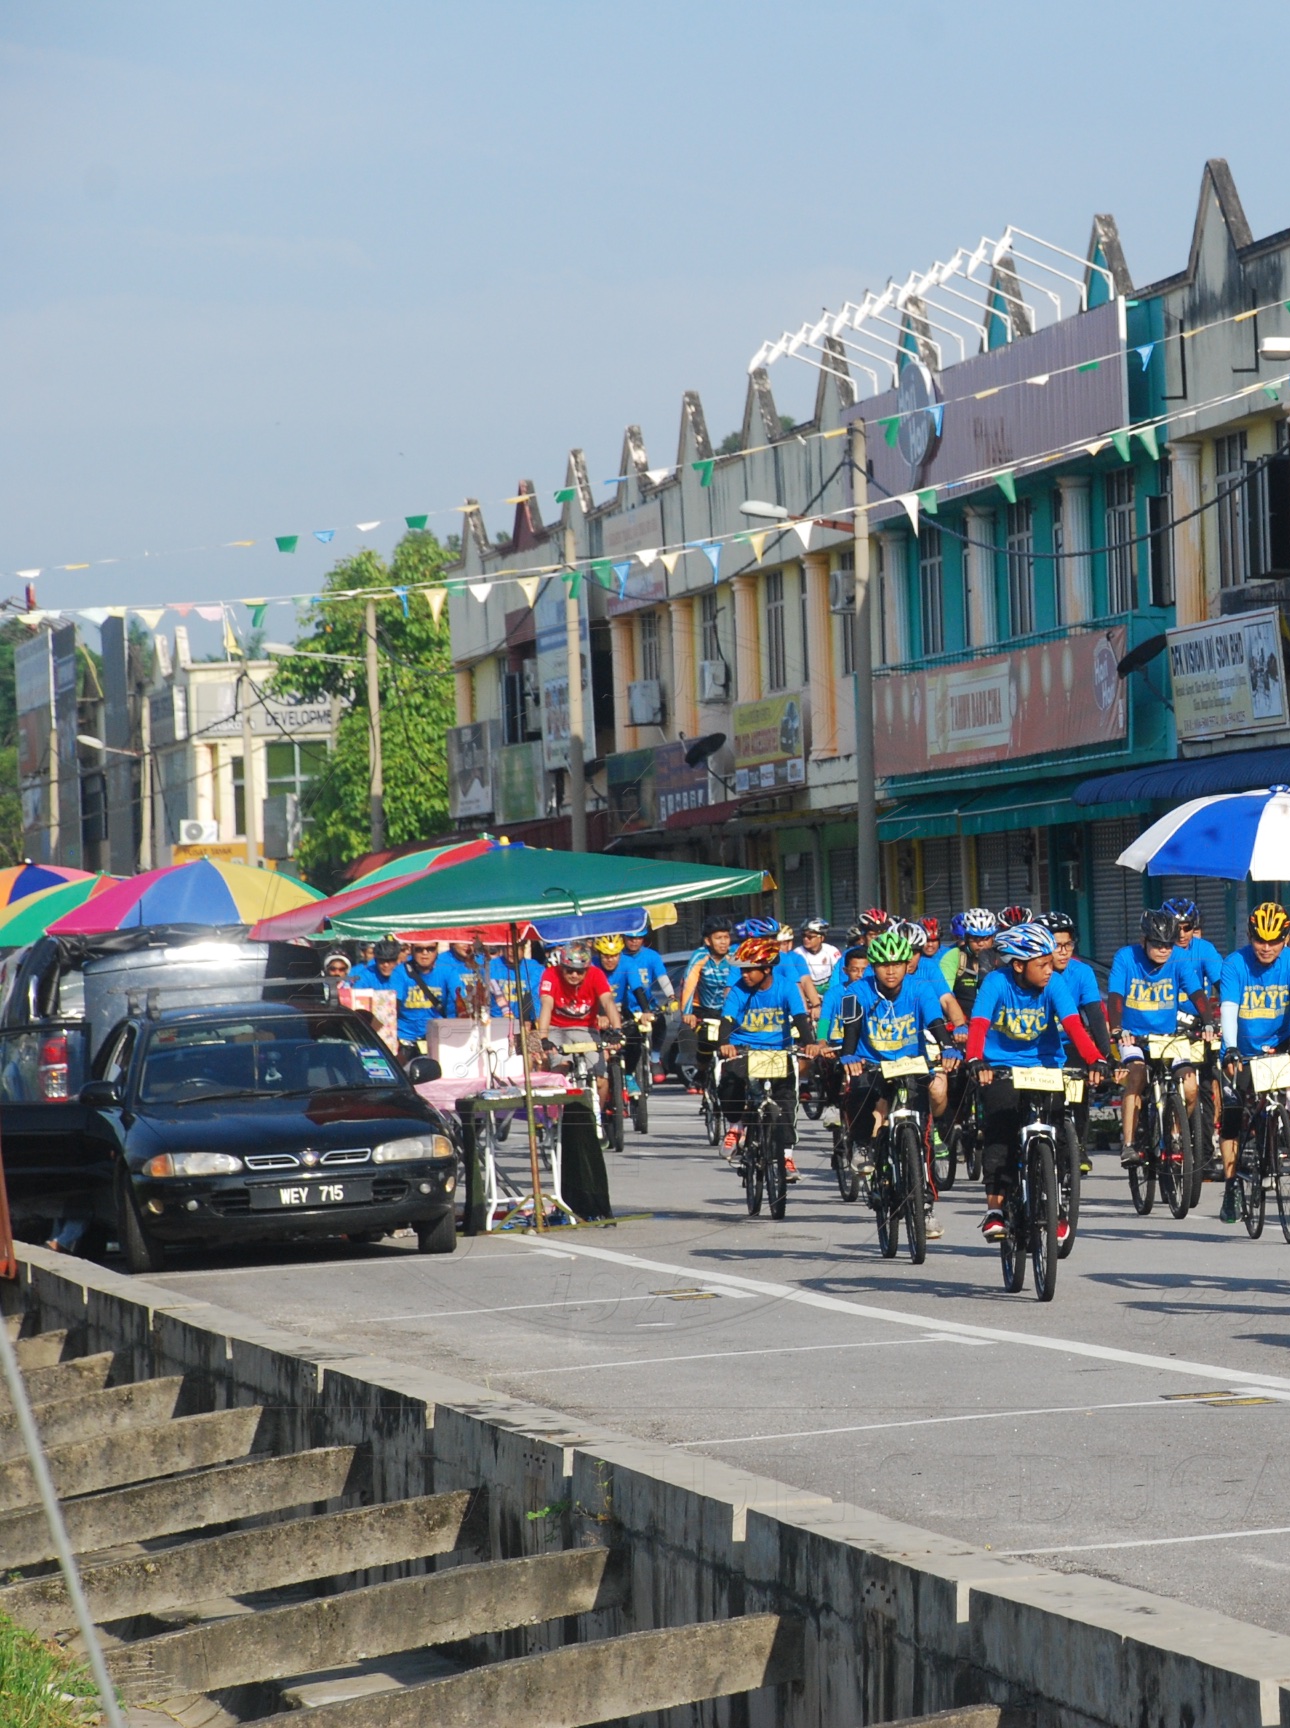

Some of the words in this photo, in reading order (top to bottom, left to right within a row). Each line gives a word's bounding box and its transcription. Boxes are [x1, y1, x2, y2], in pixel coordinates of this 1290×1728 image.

[265, 709, 332, 727] DEVELOPME
[1126, 983, 1175, 1002] 1MYC
[1240, 990, 1290, 1010] 1MYC
[995, 1010, 1048, 1035] 1MYC
[280, 1187, 308, 1204] WEY
[319, 1184, 344, 1202] 715
